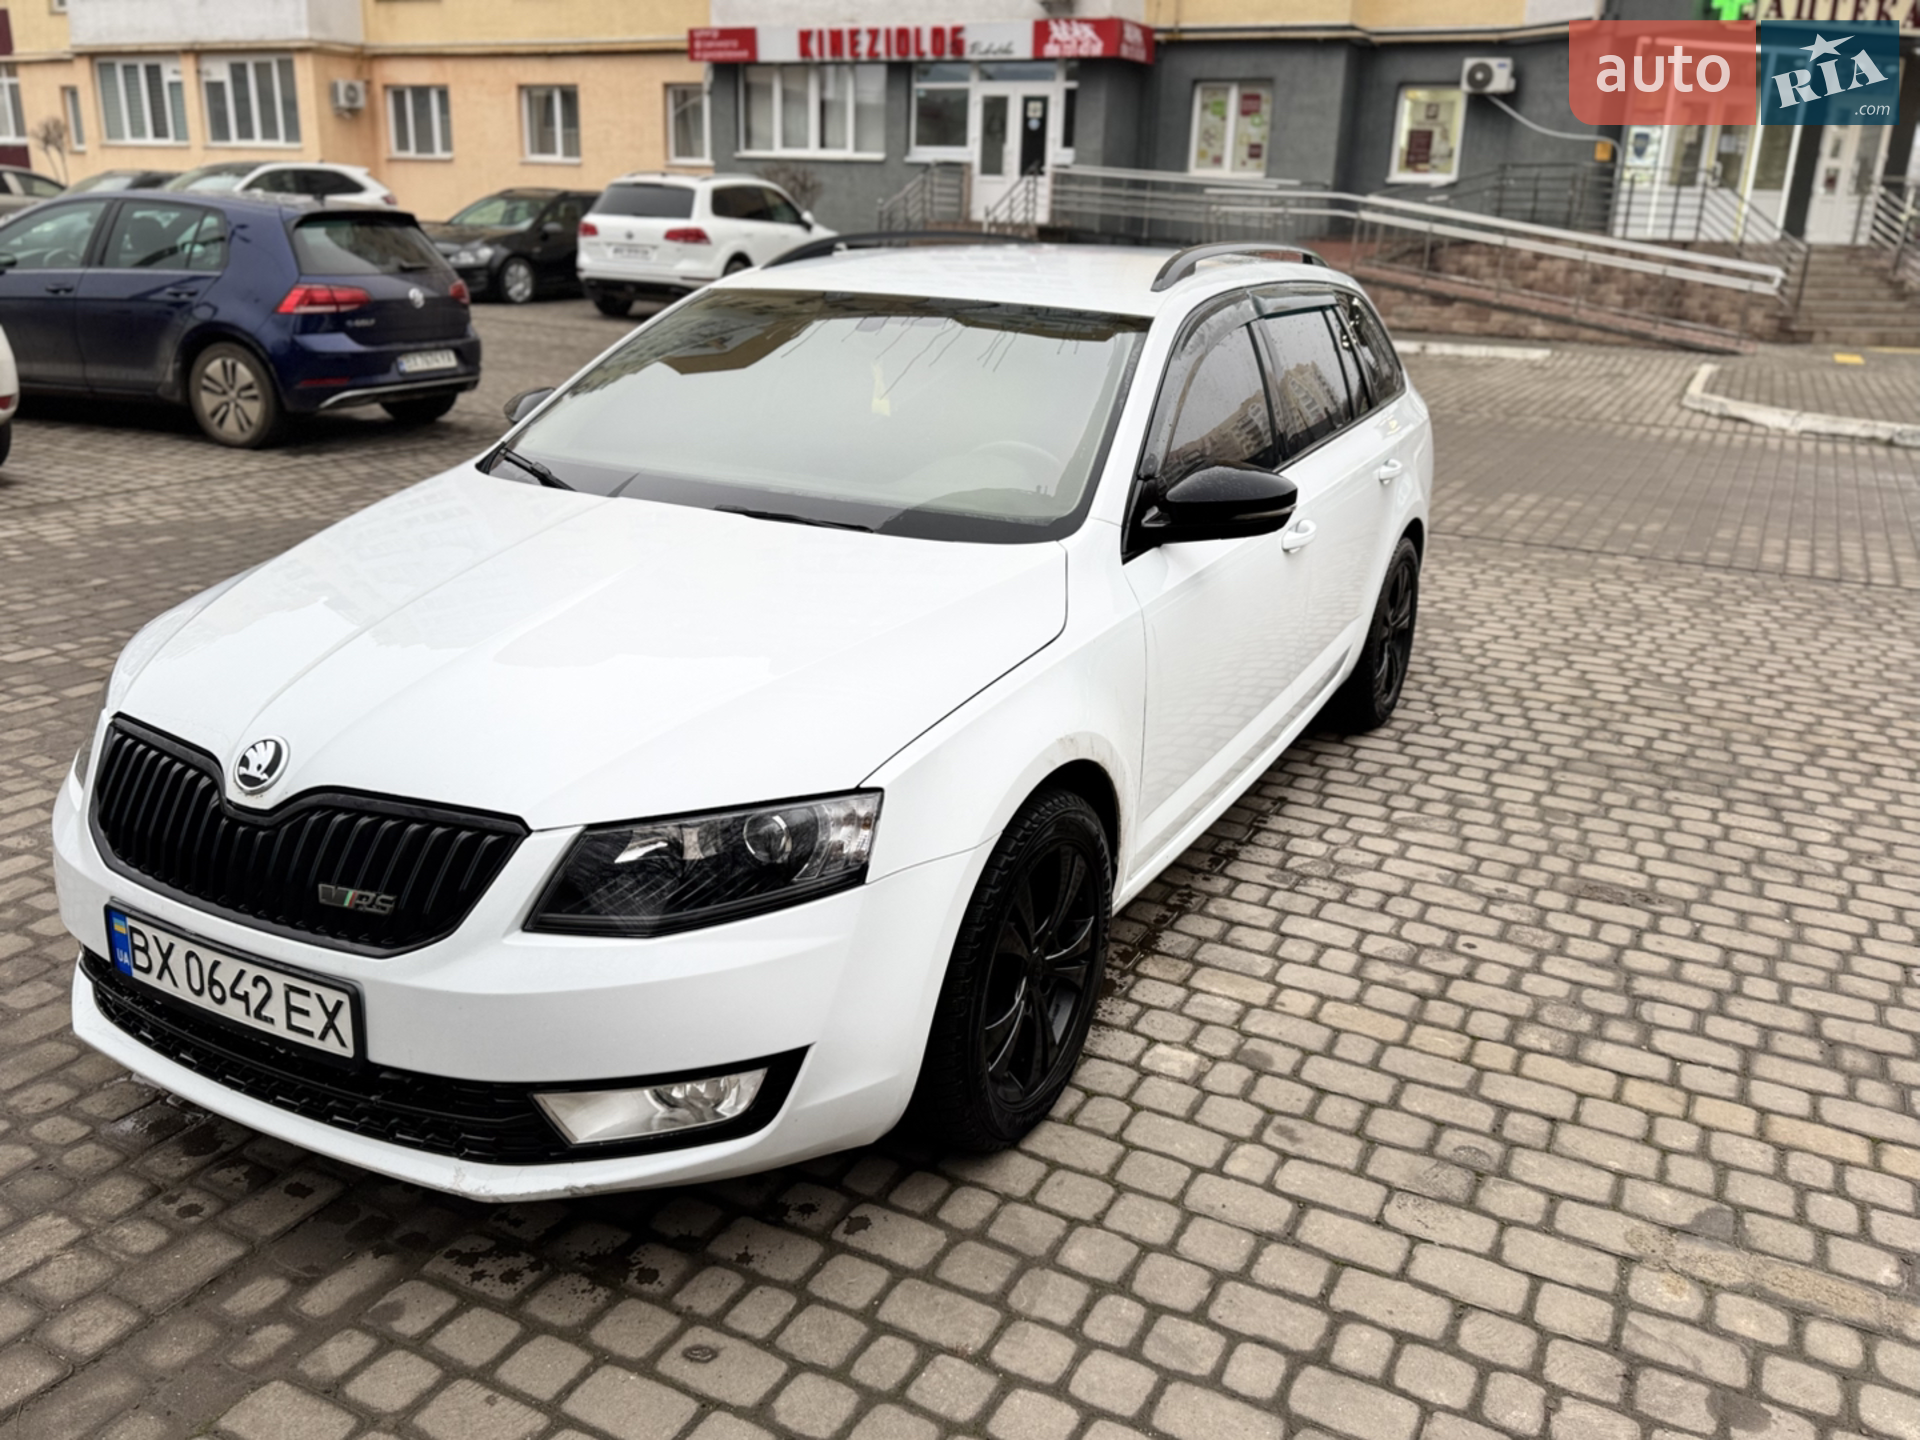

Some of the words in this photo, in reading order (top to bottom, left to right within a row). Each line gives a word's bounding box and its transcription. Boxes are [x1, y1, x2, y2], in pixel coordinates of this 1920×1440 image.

[116, 948, 130, 966] UA
[129, 925, 179, 989] BX
[185, 950, 275, 1025] 0642
[283, 983, 348, 1048] EX
